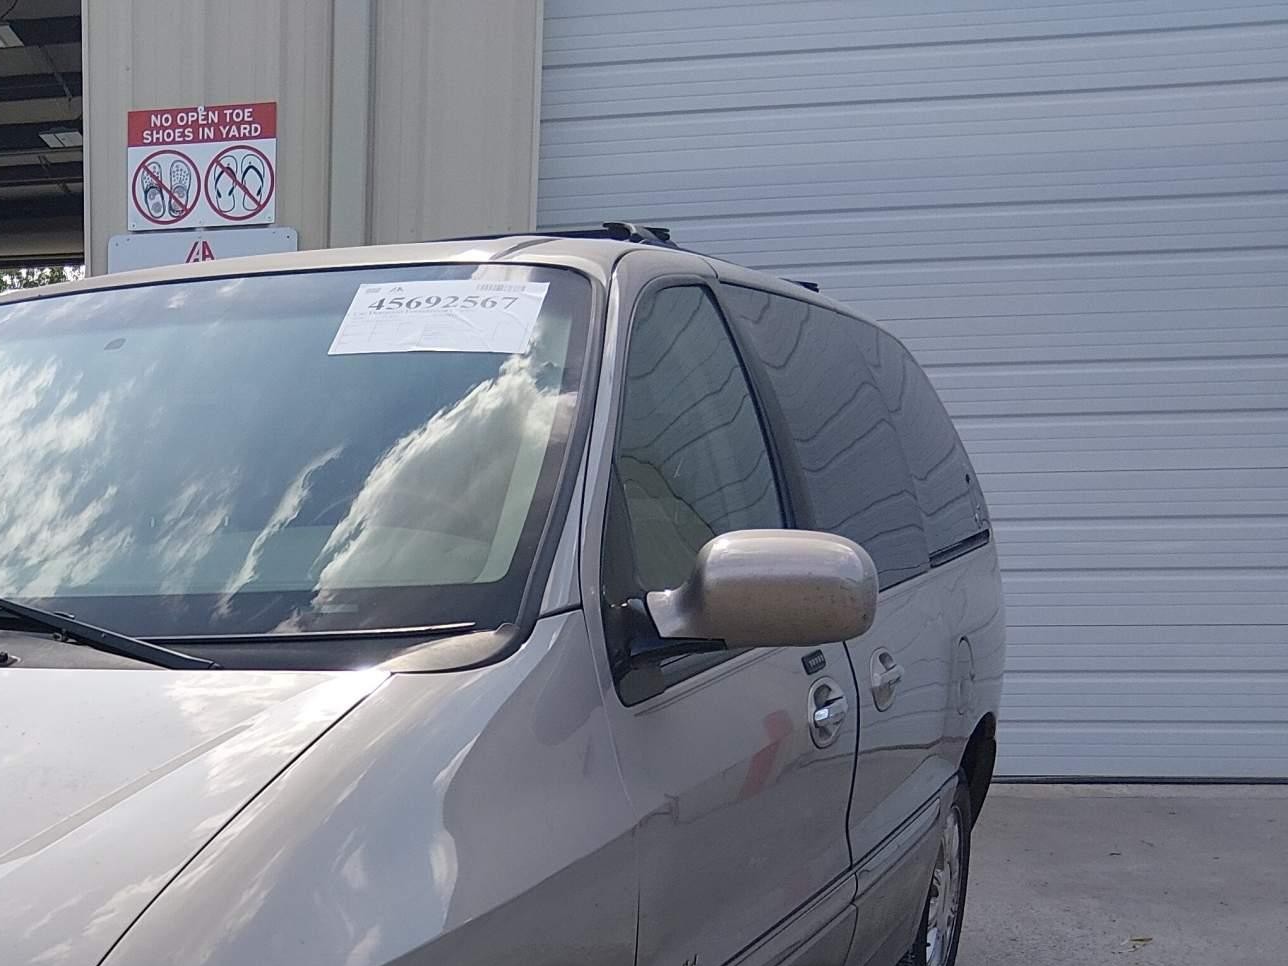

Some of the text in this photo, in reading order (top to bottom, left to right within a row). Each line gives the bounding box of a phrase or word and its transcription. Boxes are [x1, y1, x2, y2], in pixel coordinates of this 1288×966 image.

[151, 108, 253, 127] NO OPEN TOE
[143, 124, 261, 143] SHOES IN YARD
[368, 295, 520, 311] 45692567
